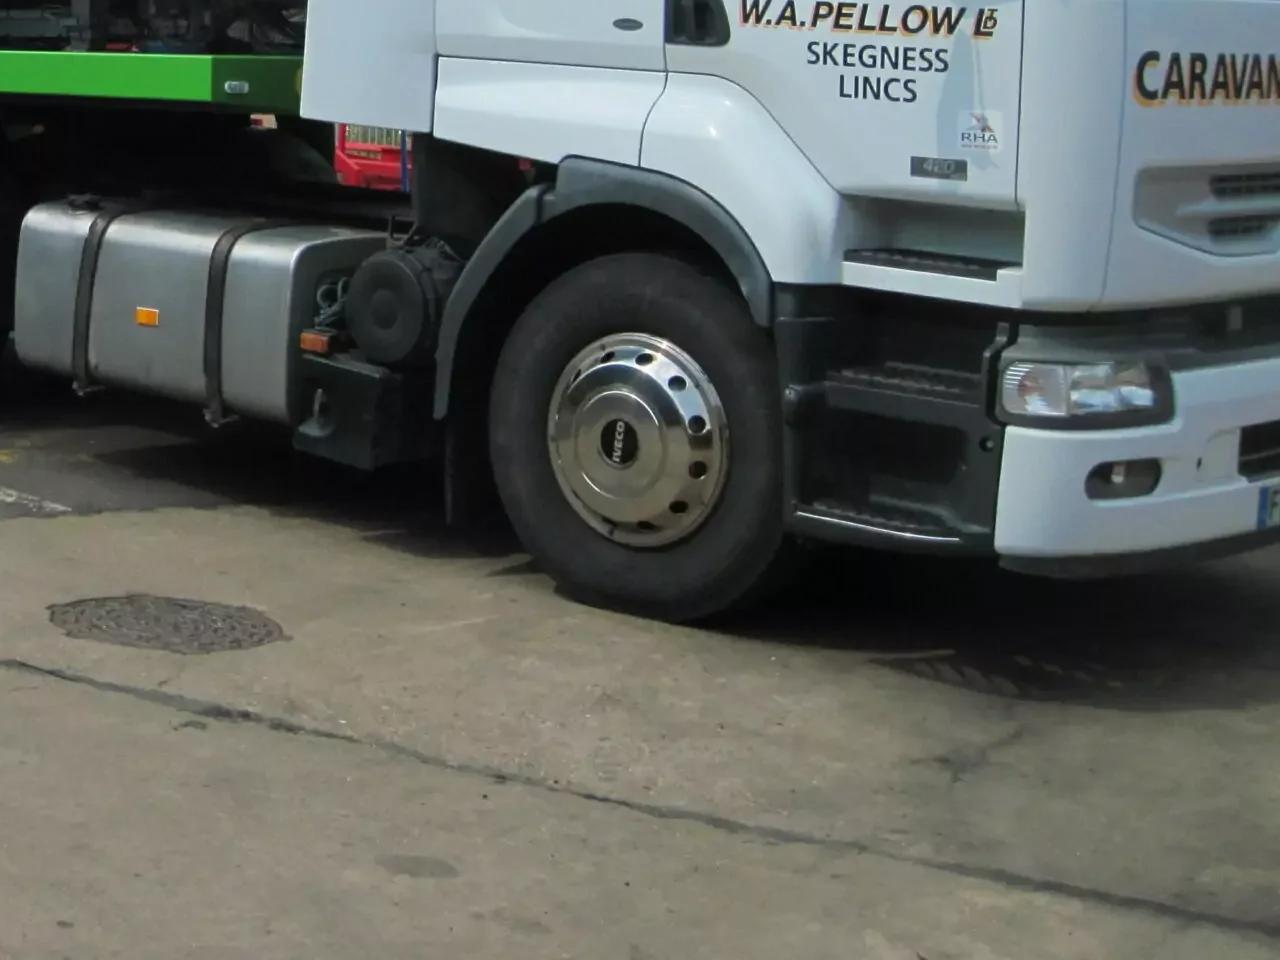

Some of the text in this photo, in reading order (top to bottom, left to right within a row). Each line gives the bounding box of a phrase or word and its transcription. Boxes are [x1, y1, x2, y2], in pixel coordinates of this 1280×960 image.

[806, 40, 950, 73] SKEGNESS
[838, 74, 918, 103] LINCS
[960, 132, 999, 144] RHA
[612, 420, 626, 463] IVECO
